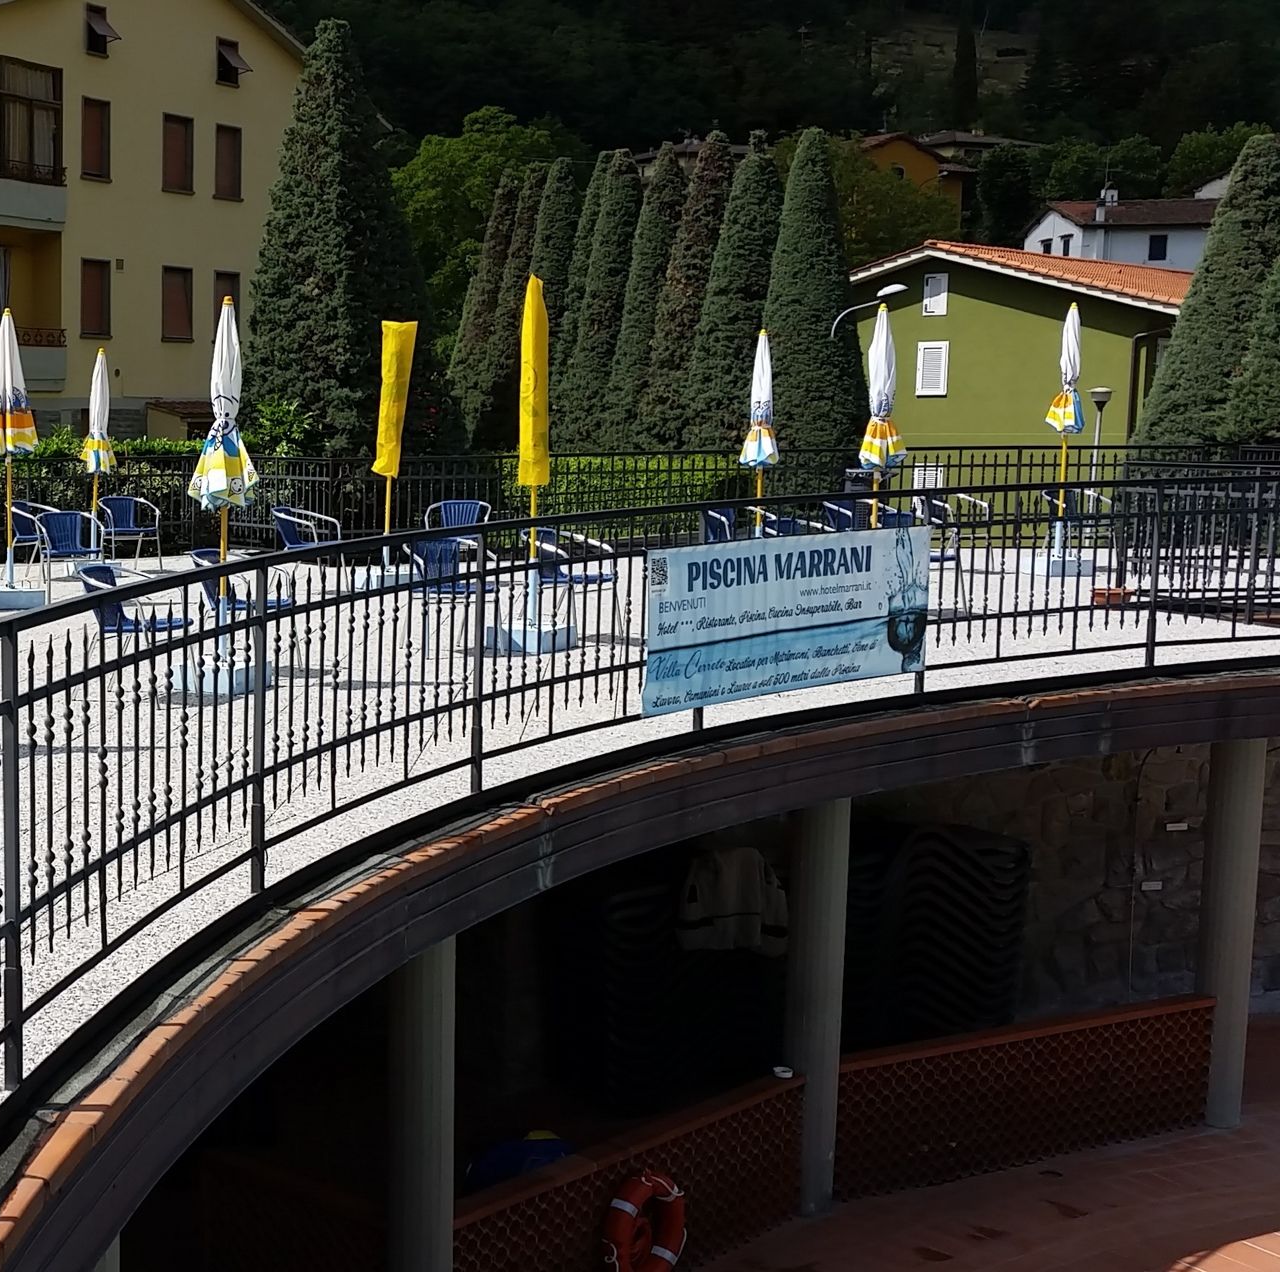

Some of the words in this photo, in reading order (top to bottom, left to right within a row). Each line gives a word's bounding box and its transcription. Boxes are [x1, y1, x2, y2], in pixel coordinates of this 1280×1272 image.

[687, 554, 769, 593] PISCINA
[774, 545, 872, 581] MARRANI
[800, 581, 872, 597] www.hotelmarrani.it
[659, 597, 707, 614] BENVENUTI
[657, 620, 679, 636] Hotel
[845, 598, 862, 611] Bar
[773, 671, 790, 686] 500
